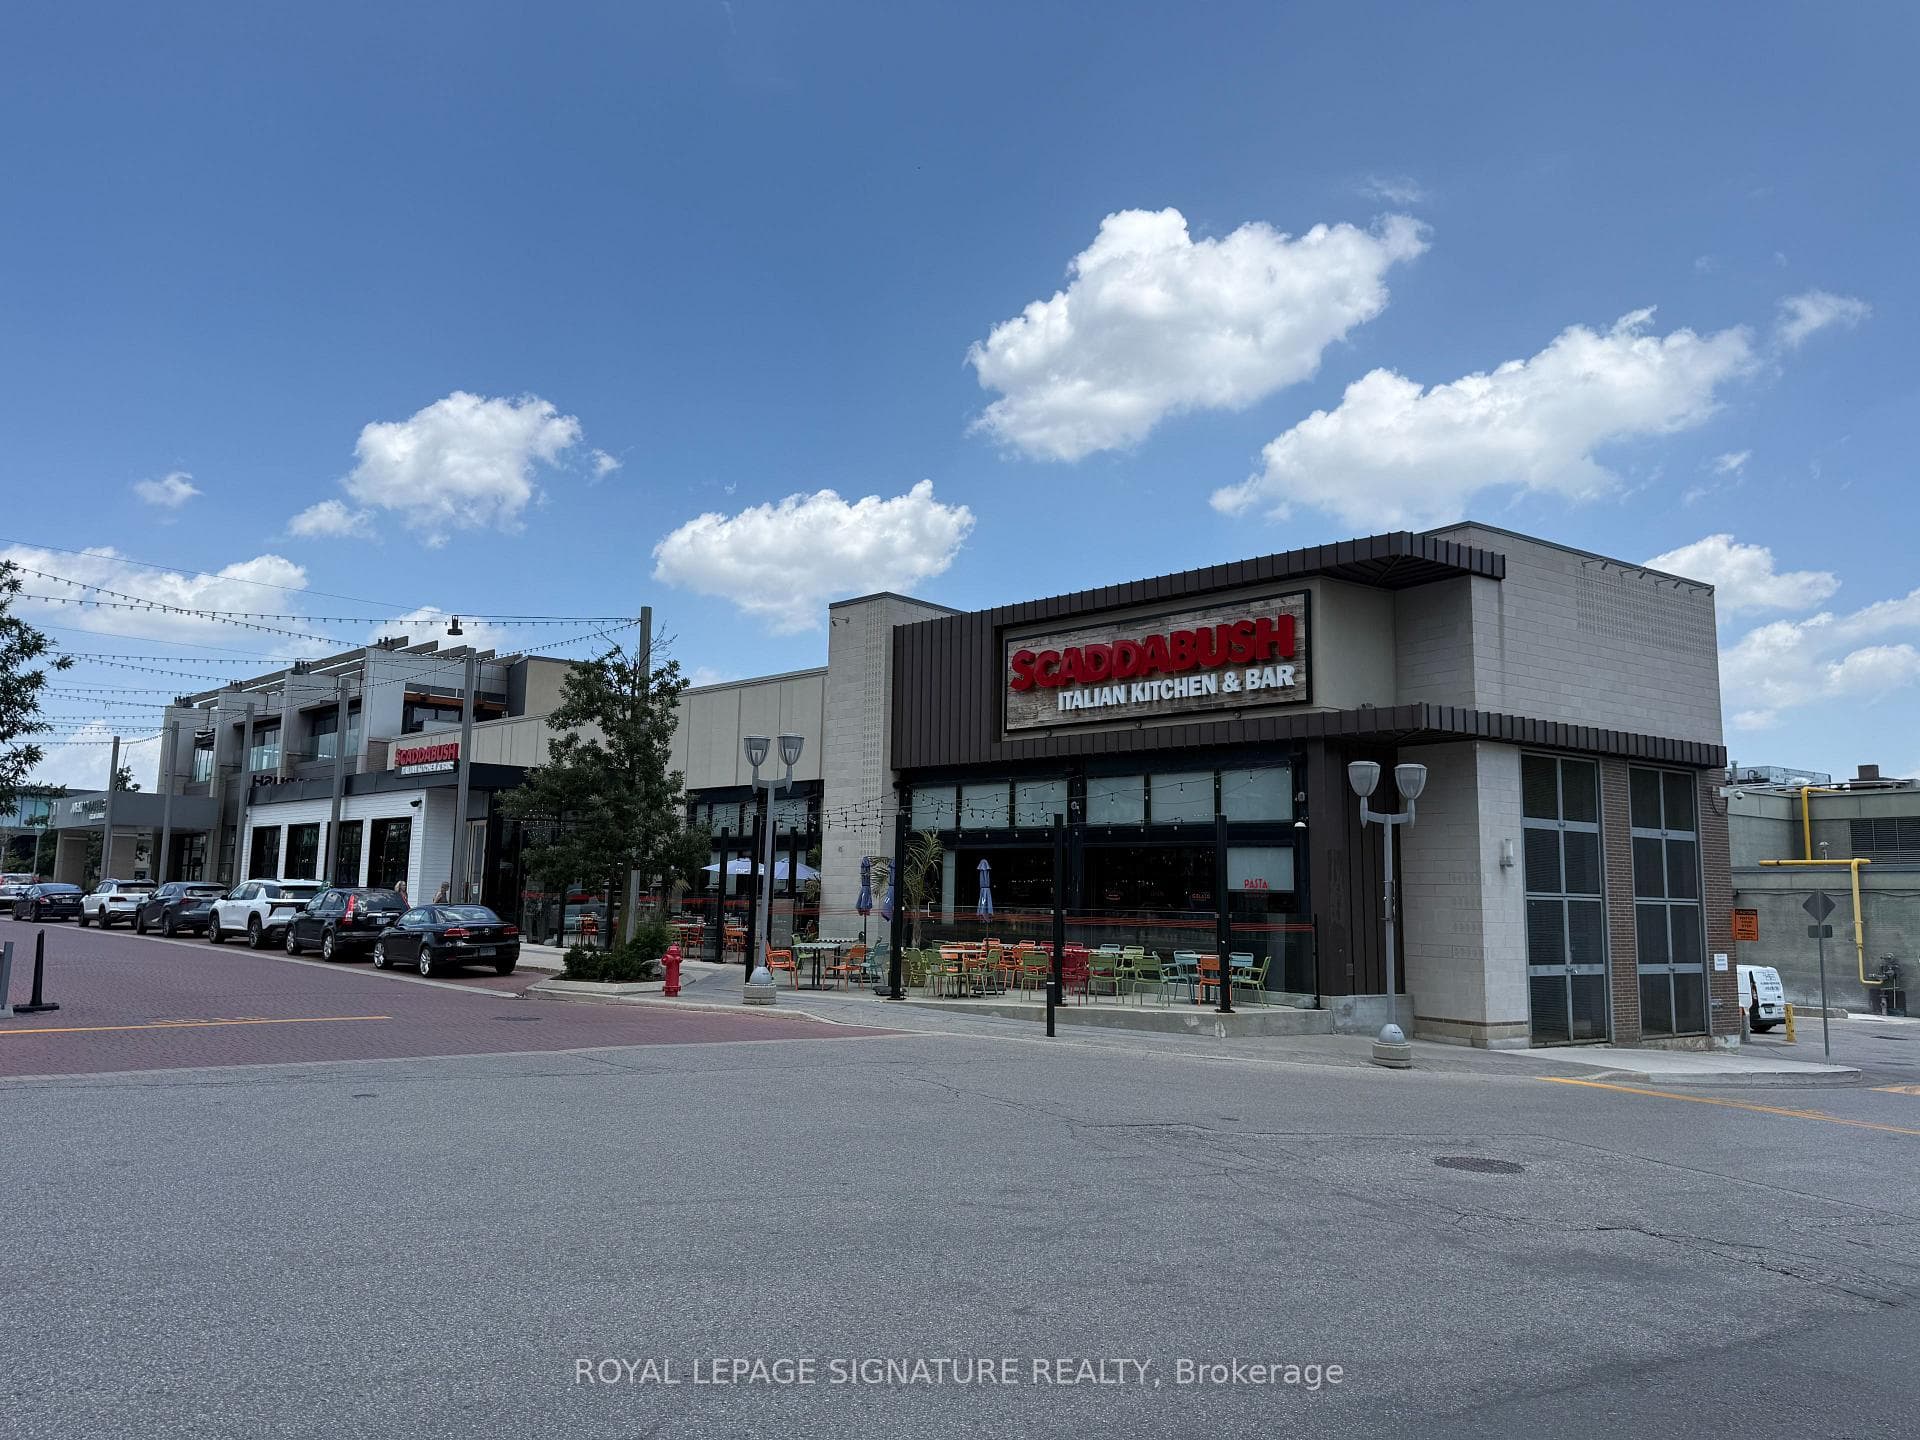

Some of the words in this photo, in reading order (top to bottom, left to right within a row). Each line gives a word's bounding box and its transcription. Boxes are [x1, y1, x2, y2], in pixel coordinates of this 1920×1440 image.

[1010, 614, 1295, 691] SCADDABUSH
[1058, 684, 1126, 711] ITALIAN
[1131, 674, 1217, 703] KITCHEN
[1222, 671, 1242, 693] &
[1246, 665, 1295, 690] BAR
[395, 743, 459, 766] SCADDABUSH
[1244, 878, 1268, 889] PASTA
